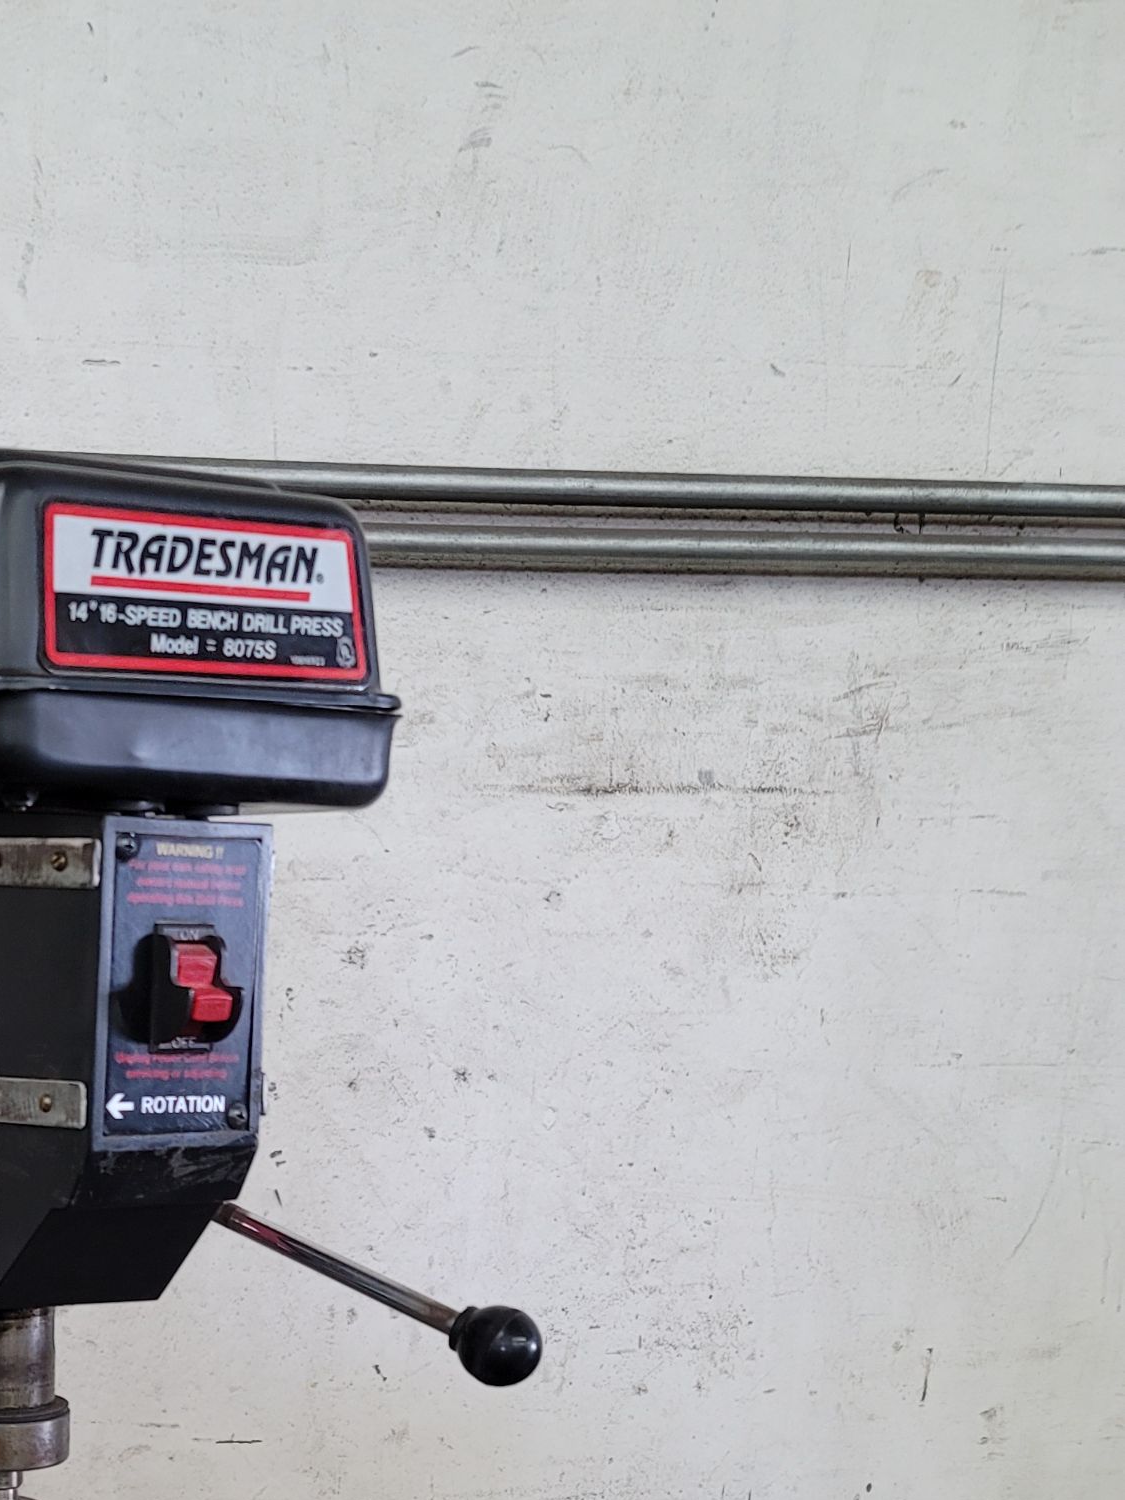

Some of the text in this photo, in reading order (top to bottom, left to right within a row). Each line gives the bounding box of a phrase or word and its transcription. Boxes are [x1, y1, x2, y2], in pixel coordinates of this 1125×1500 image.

[91, 529, 318, 584] TRADESMAN
[186, 607, 239, 632] BENCH
[241, 612, 288, 635] DRILL
[290, 615, 344, 637] PRESS
[150, 632, 199, 655] Model
[156, 842, 214, 859] WARNING
[140, 1095, 226, 1114] ROTATION
